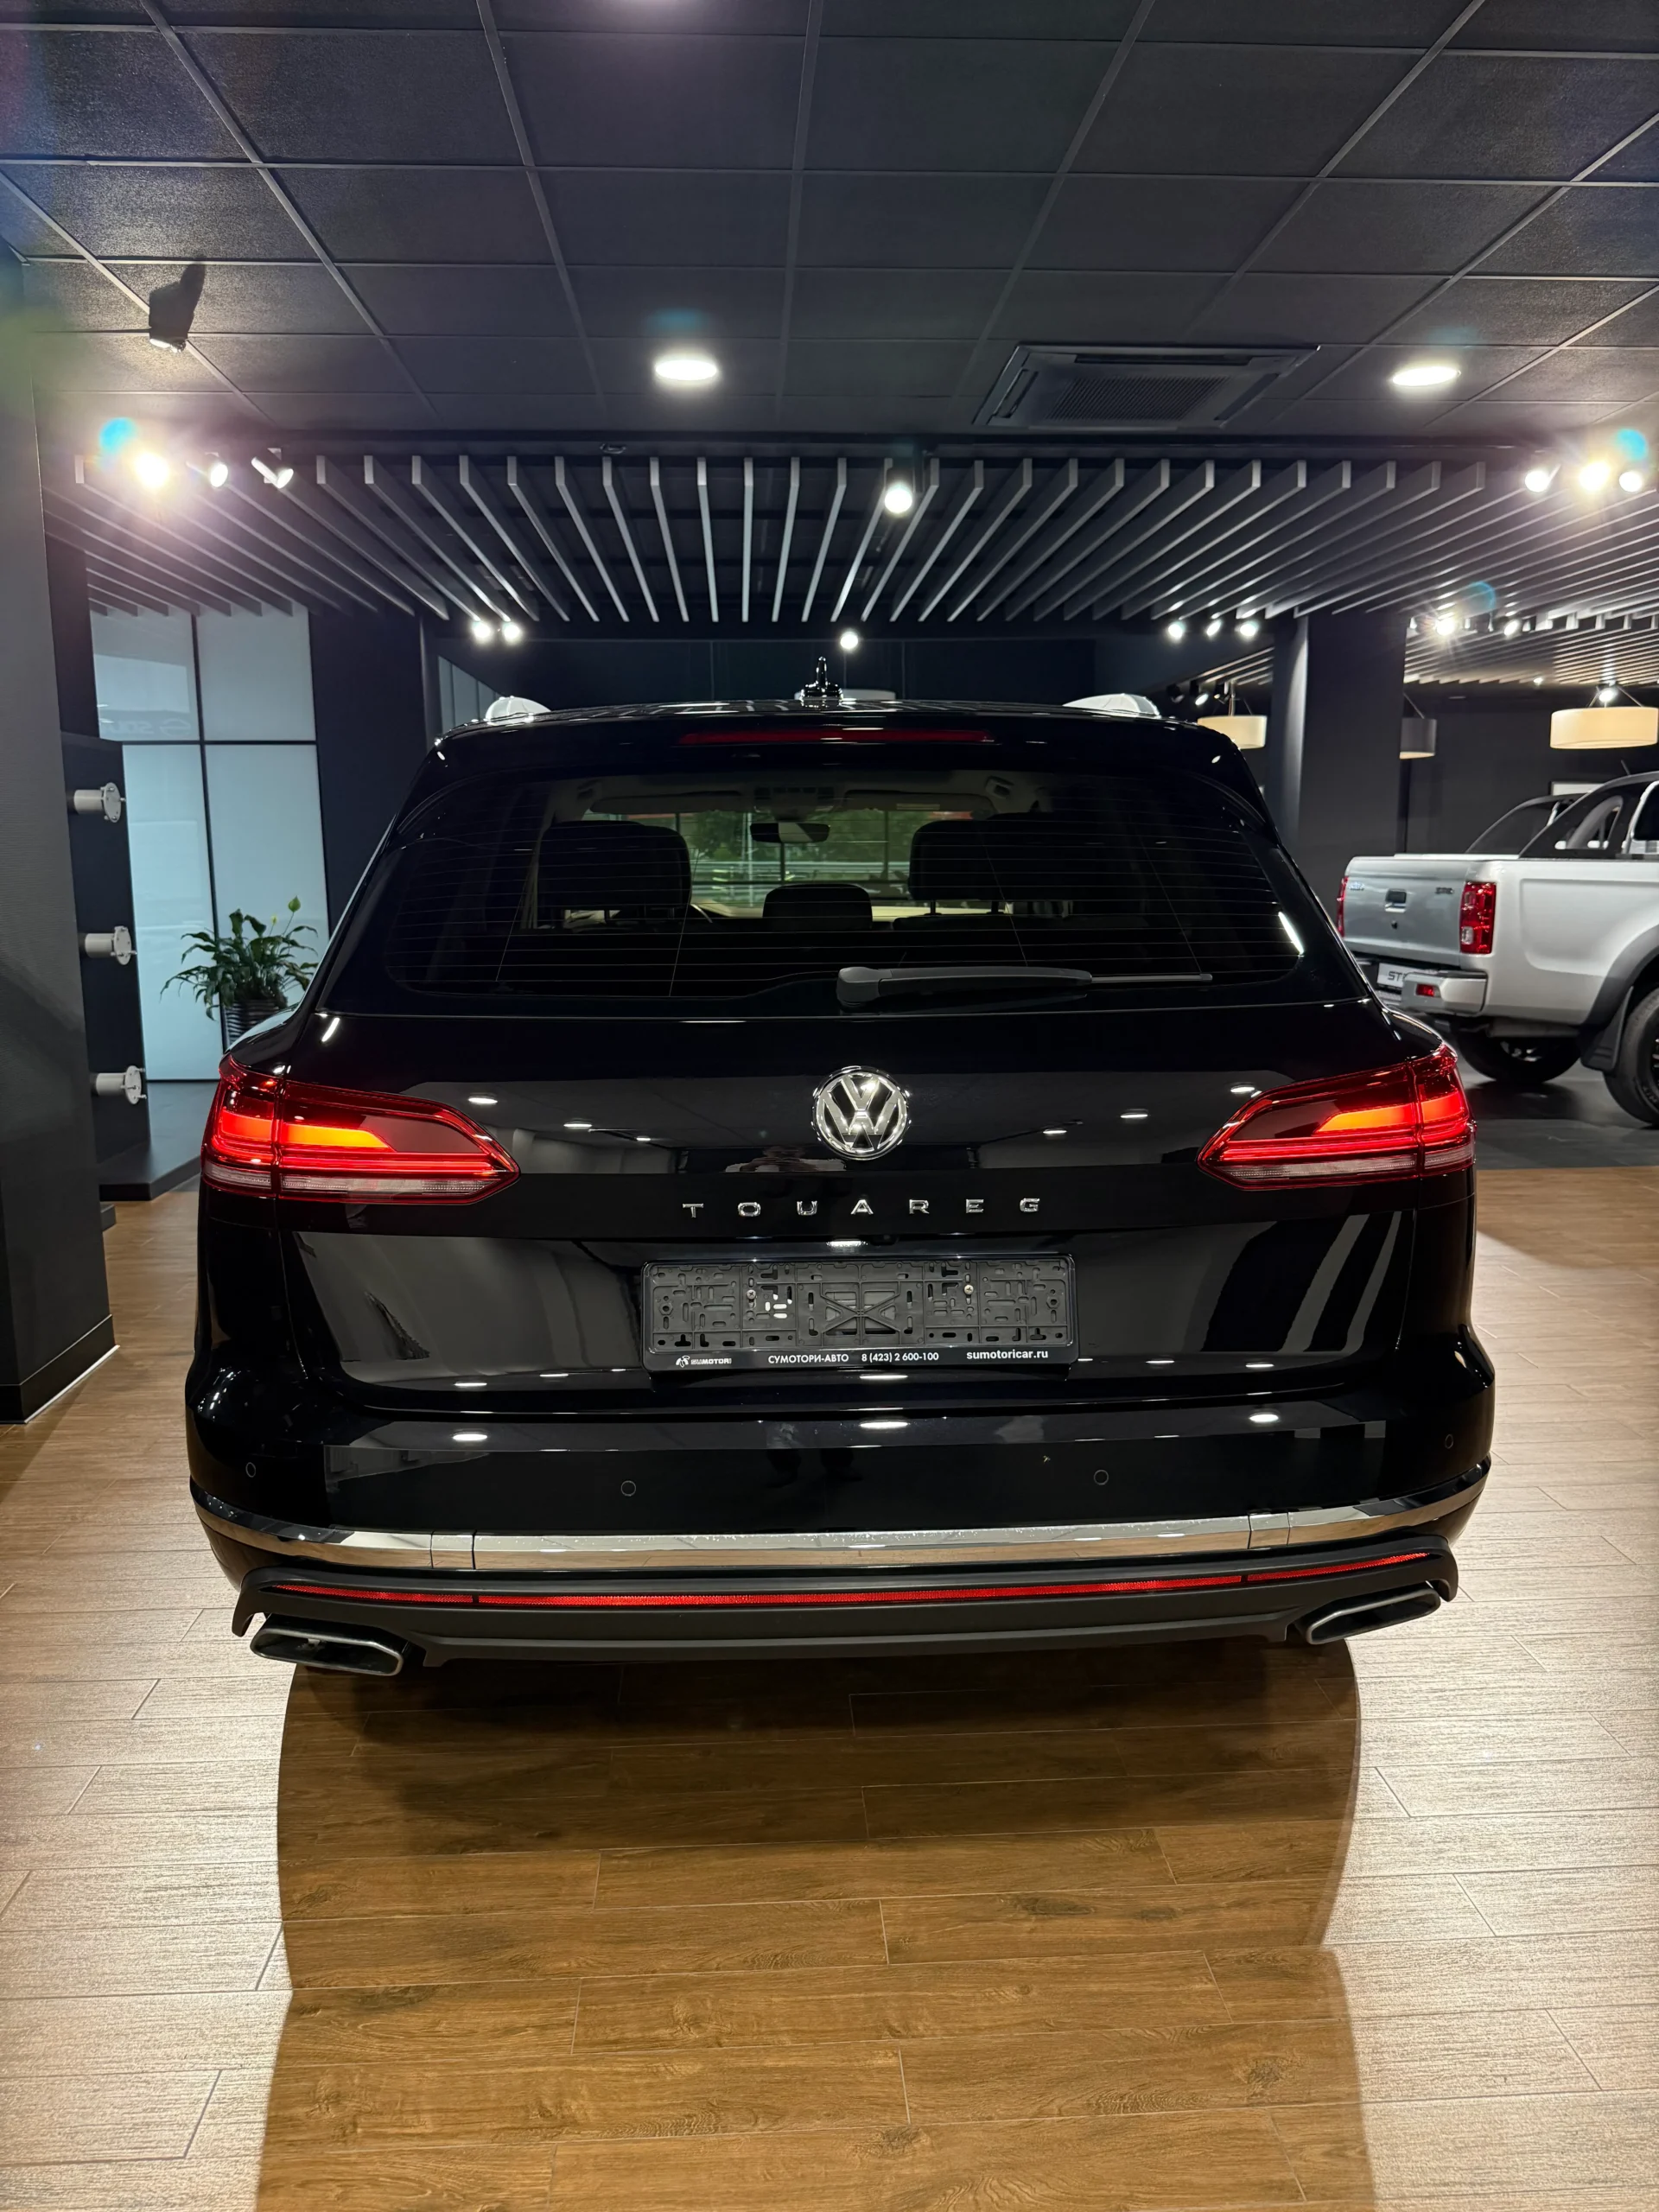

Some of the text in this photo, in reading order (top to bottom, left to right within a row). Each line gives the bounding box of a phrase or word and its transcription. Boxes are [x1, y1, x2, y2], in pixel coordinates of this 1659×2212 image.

[682, 1197, 1040, 1218] TOUAREG
[768, 1351, 939, 1363] СУМОТОРИ-АВТО 8 (423) 2 600-100
[966, 1349, 1049, 1360] sumotoricar.ru
